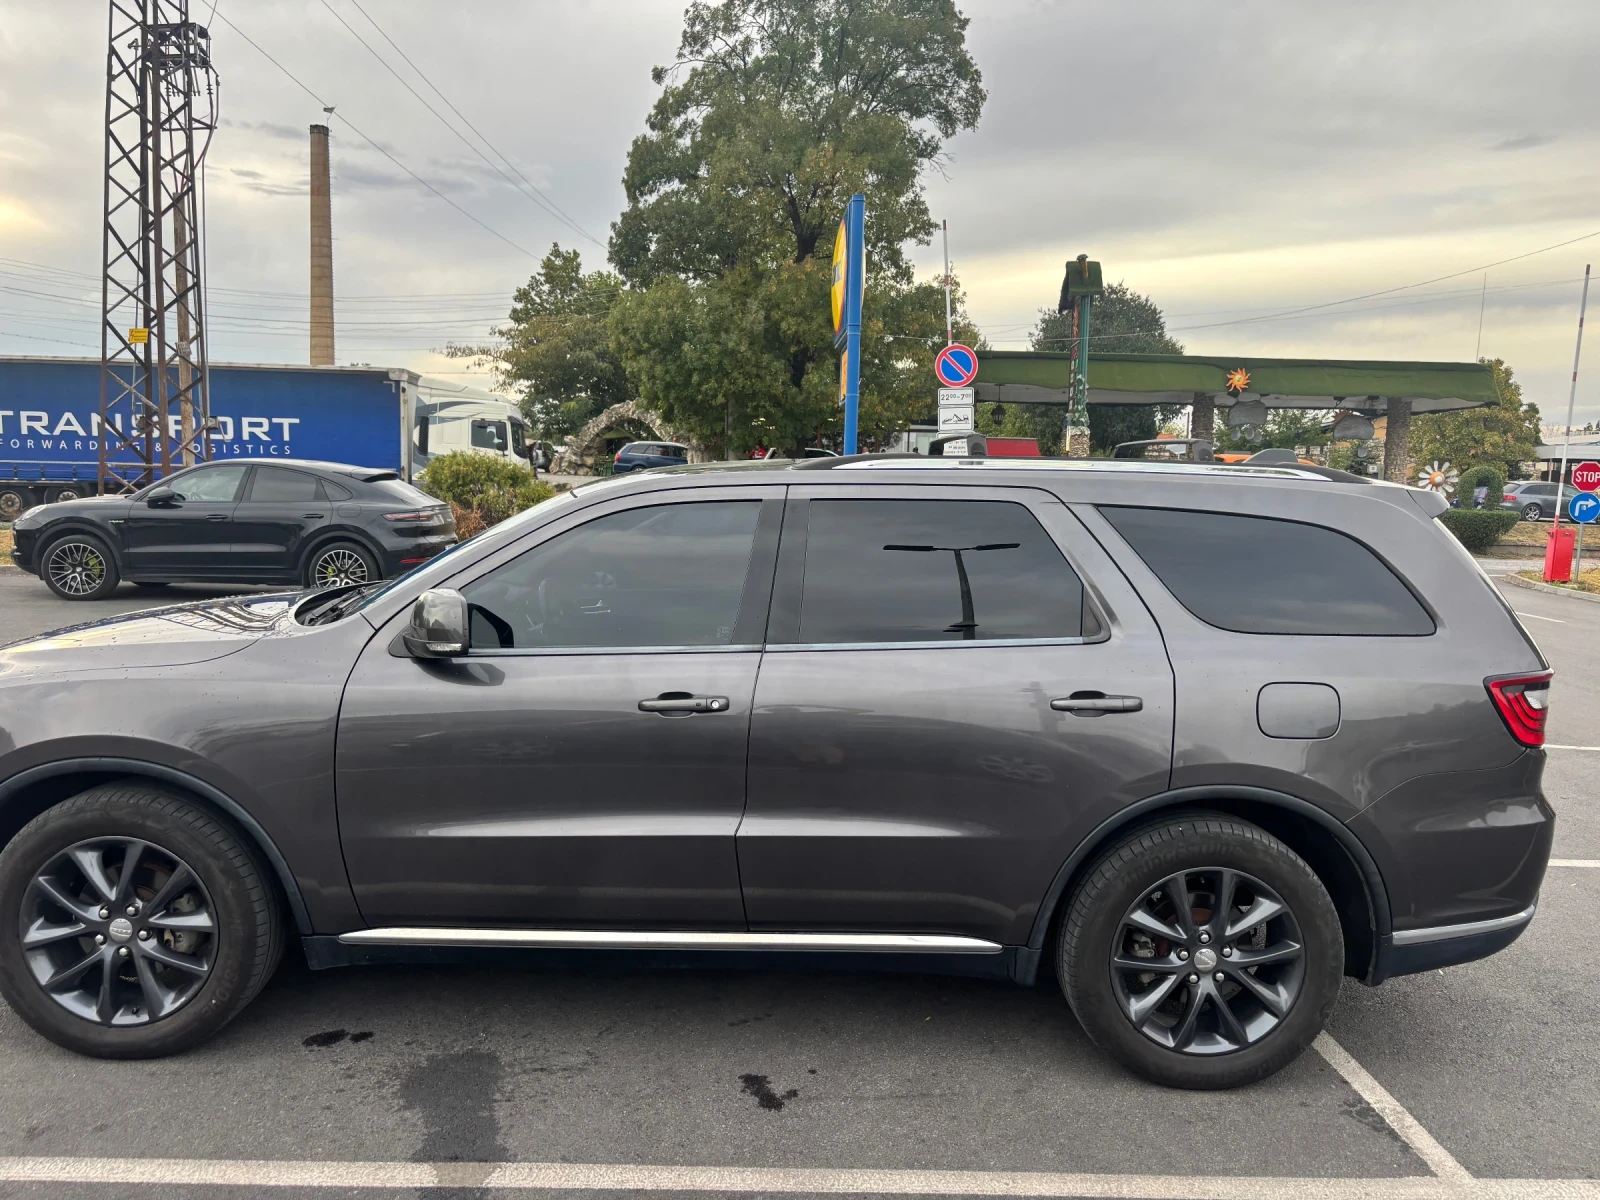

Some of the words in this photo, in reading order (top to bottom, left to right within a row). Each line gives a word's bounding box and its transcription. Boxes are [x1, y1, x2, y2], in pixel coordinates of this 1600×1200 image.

[155, 442, 162, 452] &
[180, 443, 290, 455] OGISTICS
[1575, 471, 1600, 483] STOP
